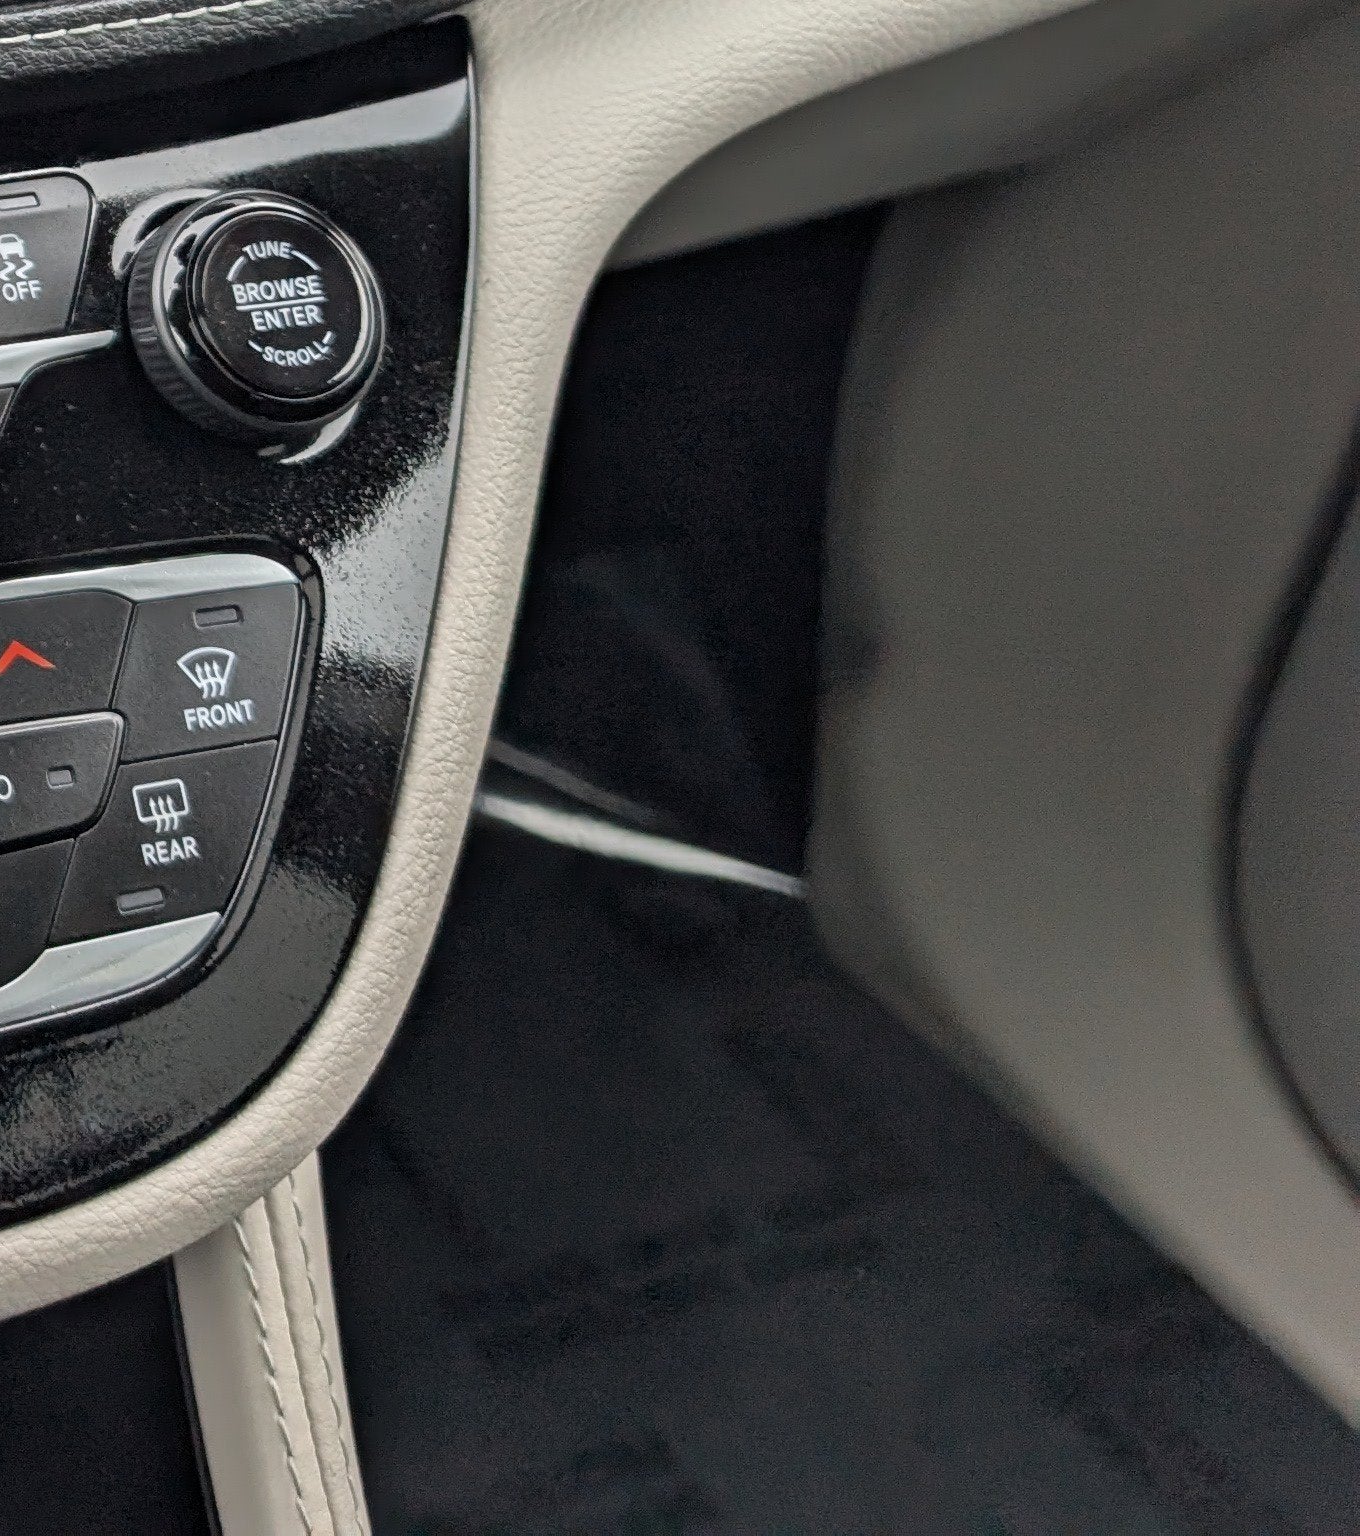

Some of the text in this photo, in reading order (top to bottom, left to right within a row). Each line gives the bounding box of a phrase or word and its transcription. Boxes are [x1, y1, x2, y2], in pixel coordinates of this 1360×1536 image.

[242, 240, 293, 260] TUNE
[2, 279, 42, 302] OFF
[232, 274, 323, 304] BROWSE
[250, 304, 324, 332] ENTER
[262, 340, 329, 367] SCROLL
[184, 699, 254, 731] FRONT
[142, 836, 199, 865] REAR
